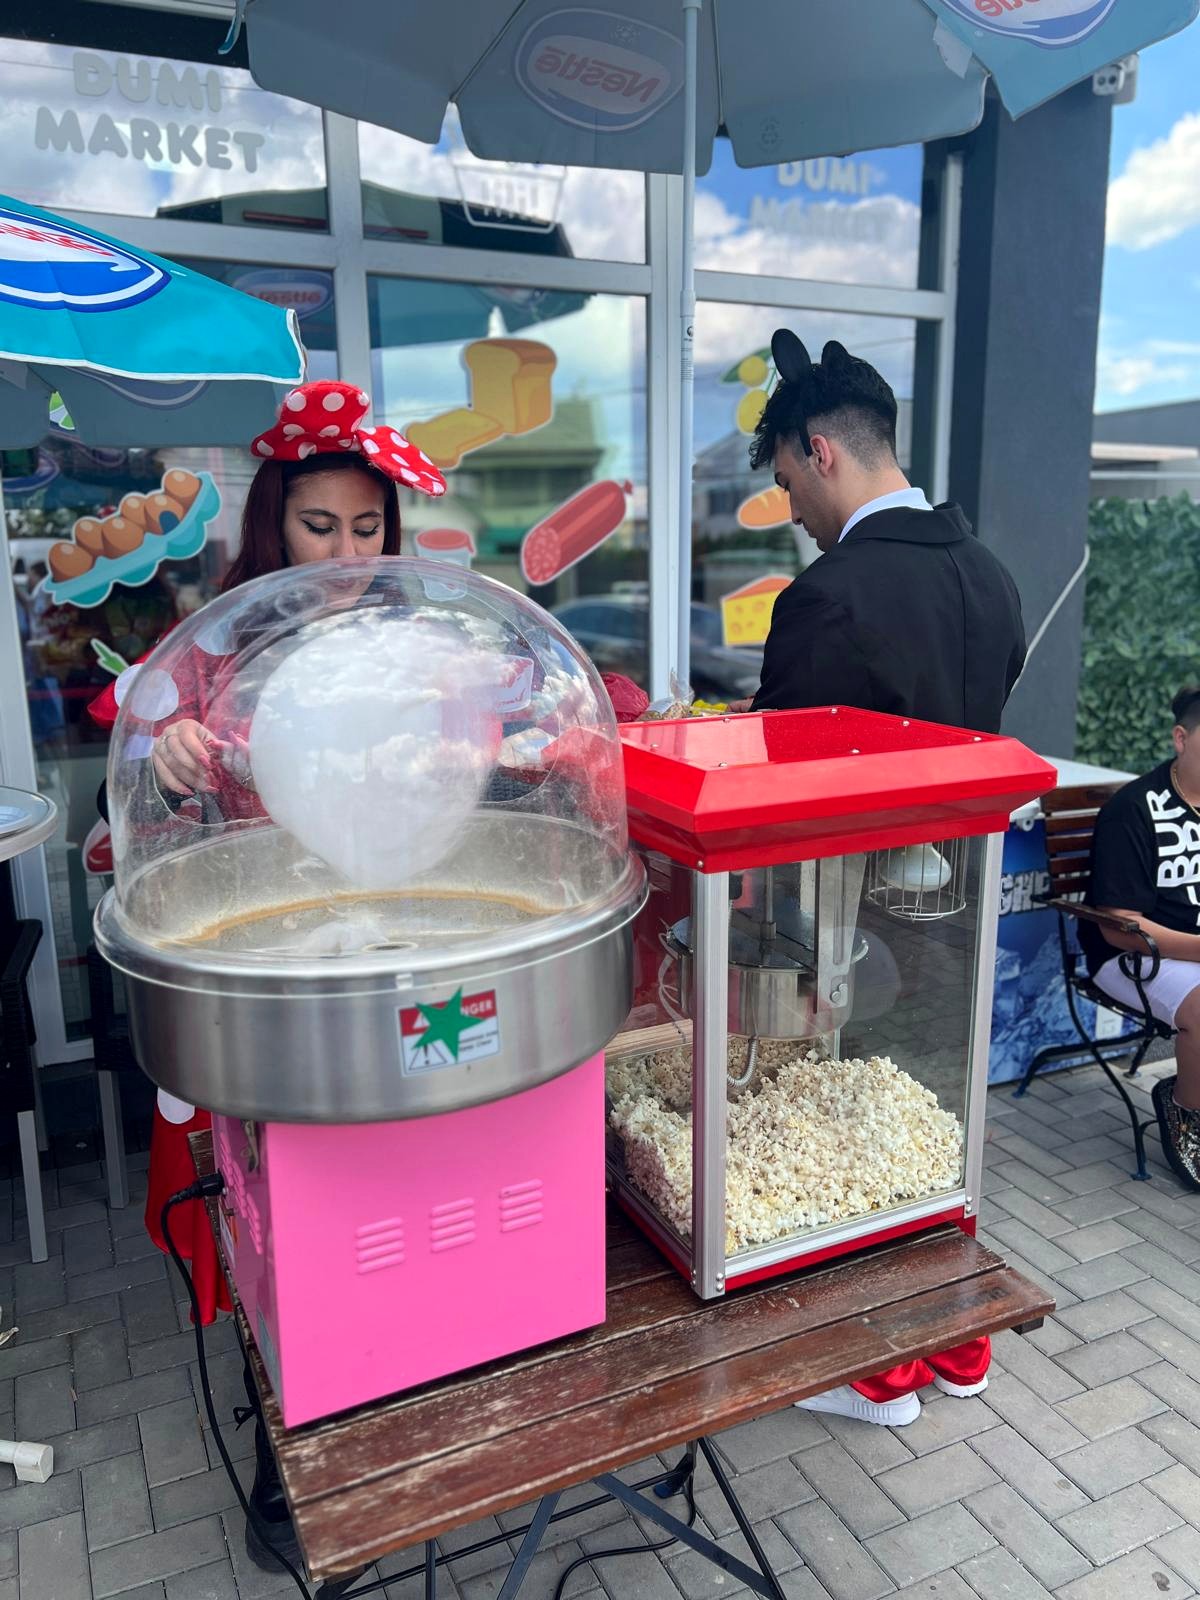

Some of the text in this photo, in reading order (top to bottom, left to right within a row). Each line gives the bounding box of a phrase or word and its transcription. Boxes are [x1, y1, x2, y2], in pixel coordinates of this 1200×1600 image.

[73, 52, 222, 113] DUMI
[34, 105, 265, 174] MARKET
[777, 157, 869, 195] DUMI
[1146, 788, 1190, 888] BUR
[461, 999, 493, 1017] NGER
